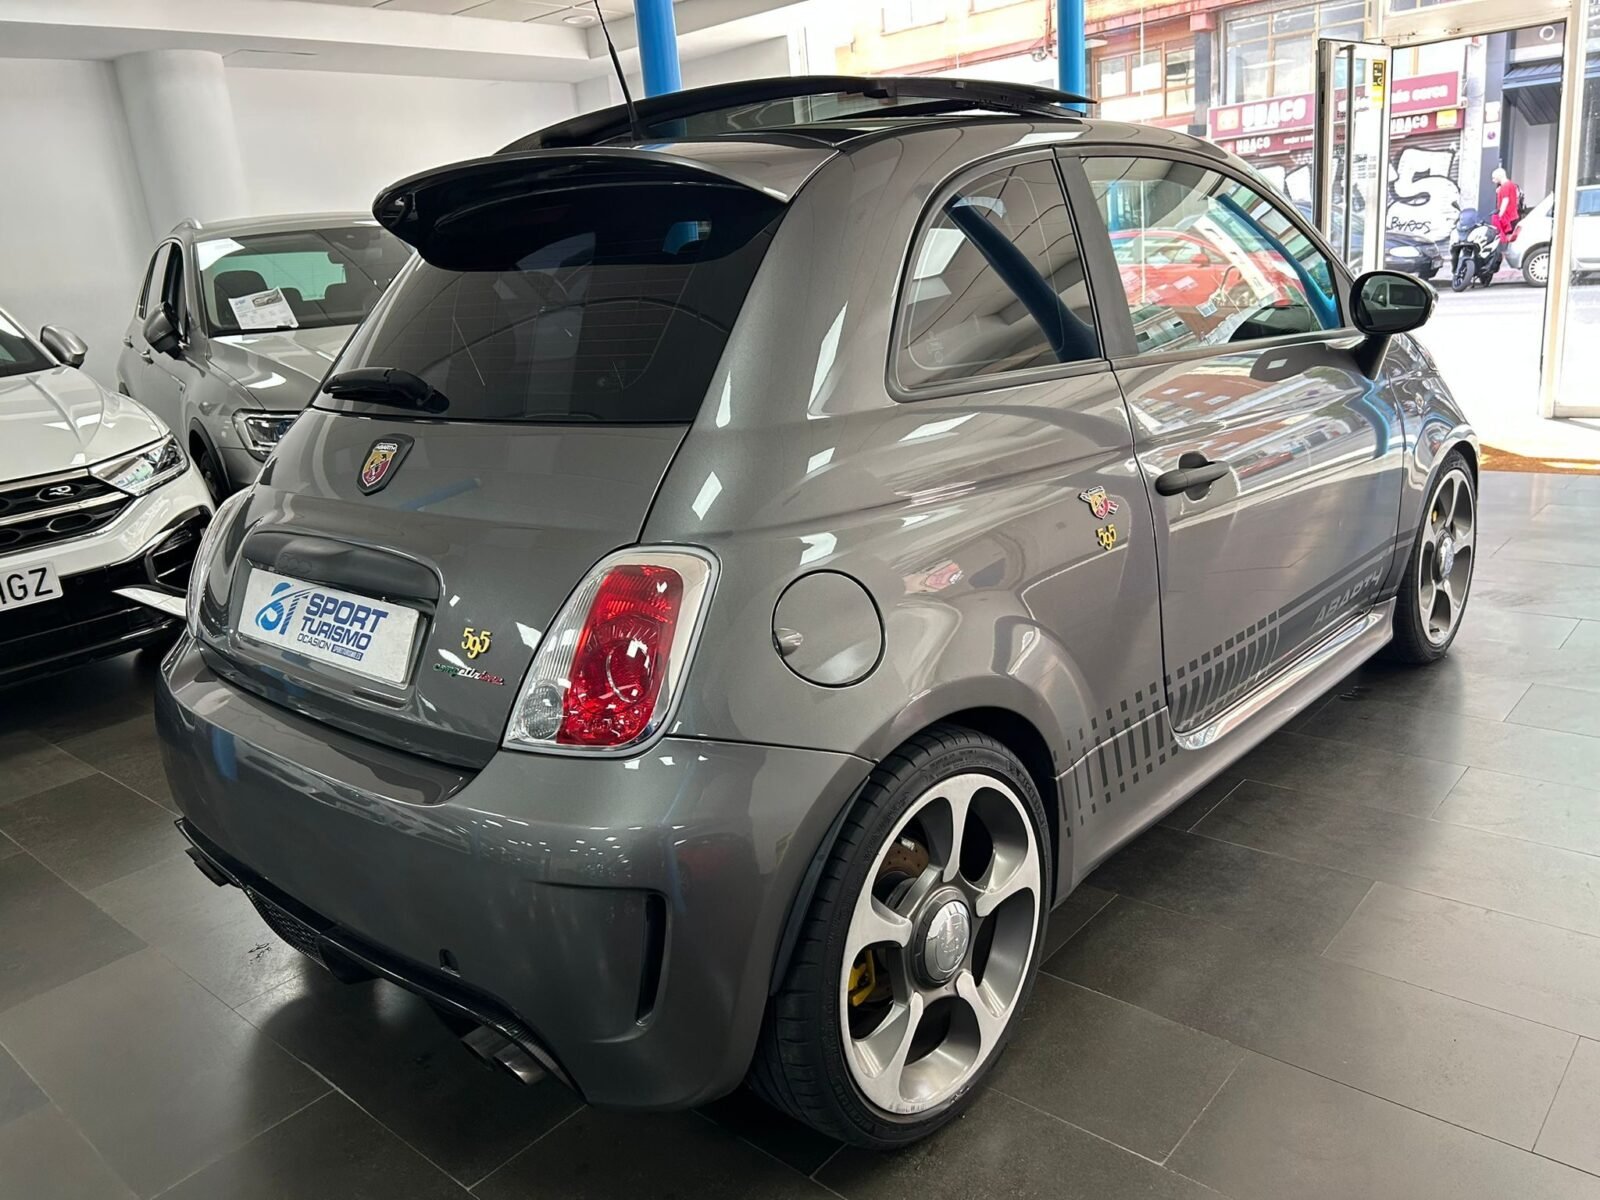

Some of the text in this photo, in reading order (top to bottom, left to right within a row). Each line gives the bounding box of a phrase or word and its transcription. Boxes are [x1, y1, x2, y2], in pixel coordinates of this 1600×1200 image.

[1096, 524, 1117, 551] 595
[305, 593, 389, 633] SPORT
[297, 633, 332, 651] OCASION
[300, 616, 372, 651] TURISMO
[461, 627, 493, 659] 595
